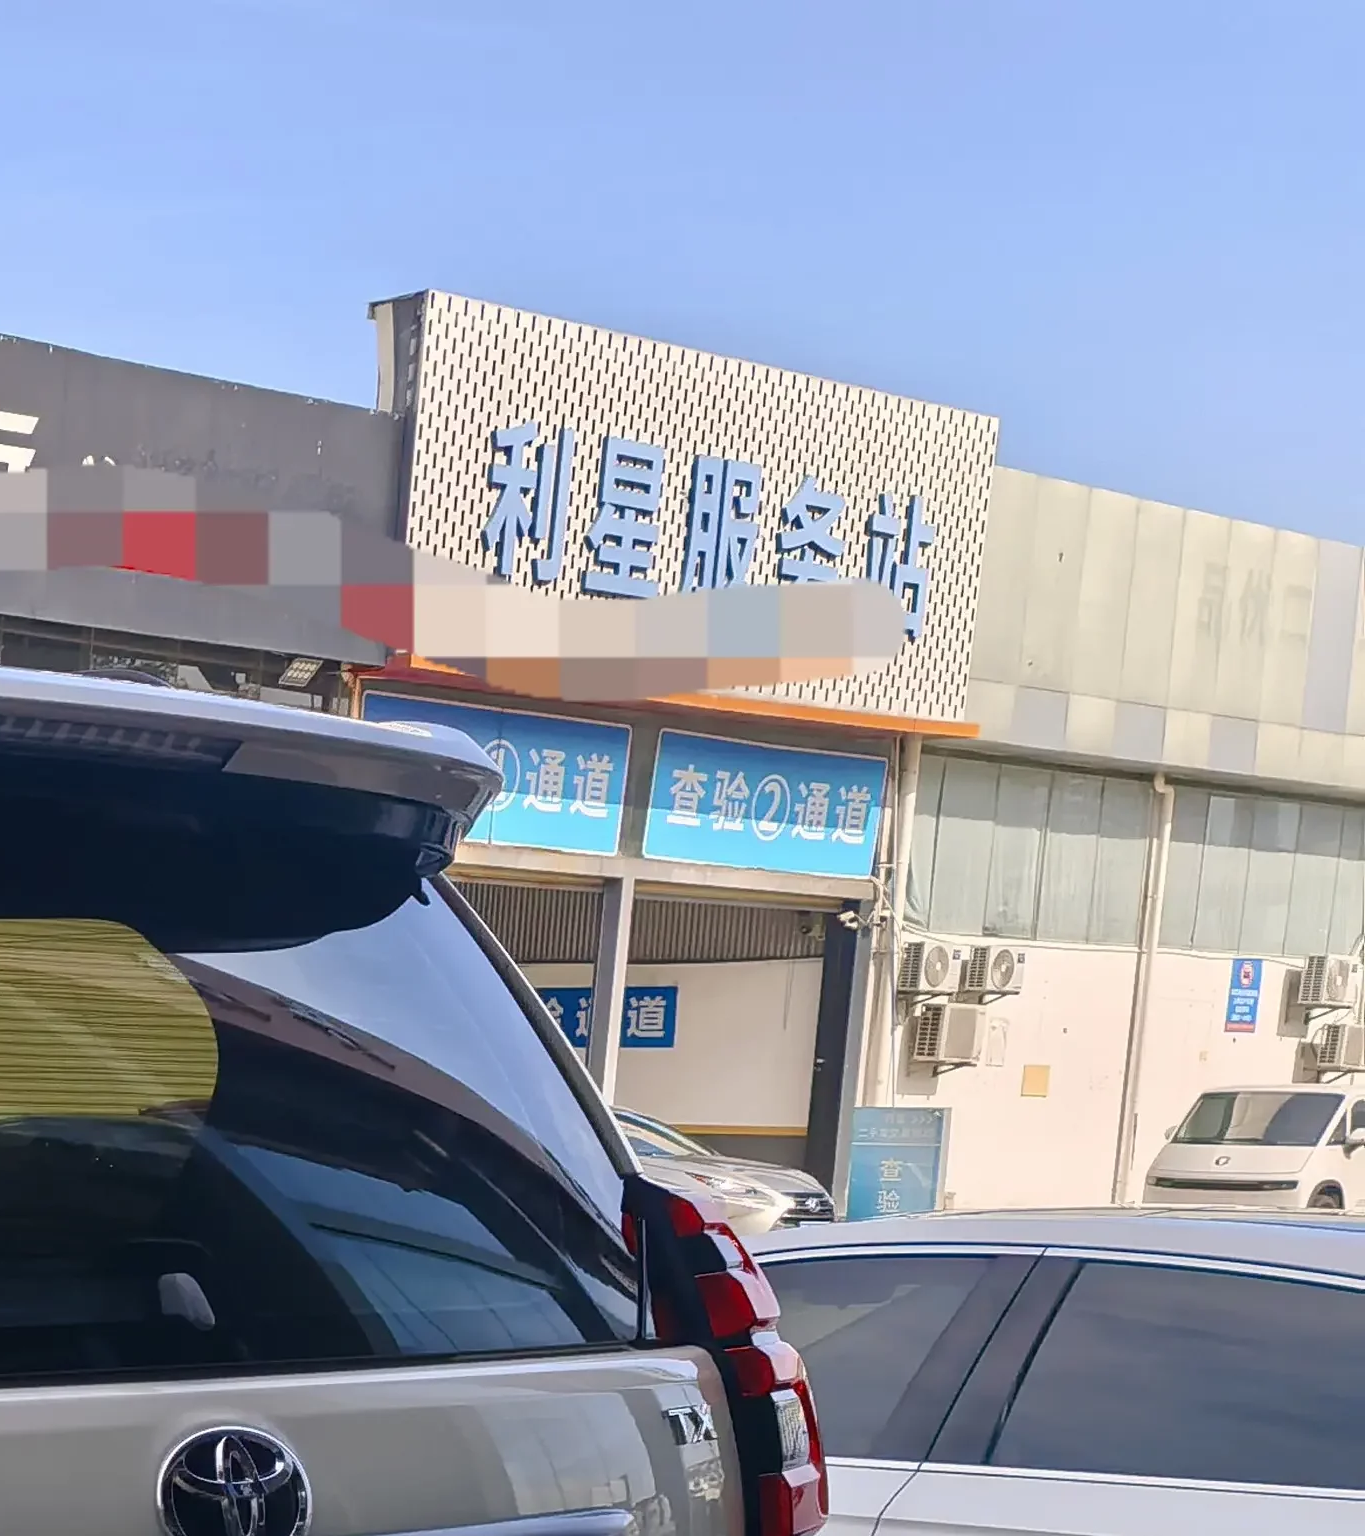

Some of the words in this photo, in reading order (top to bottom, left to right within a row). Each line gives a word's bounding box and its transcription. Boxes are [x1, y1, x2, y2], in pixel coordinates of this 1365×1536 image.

[481, 420, 936, 642] 利星服务站
